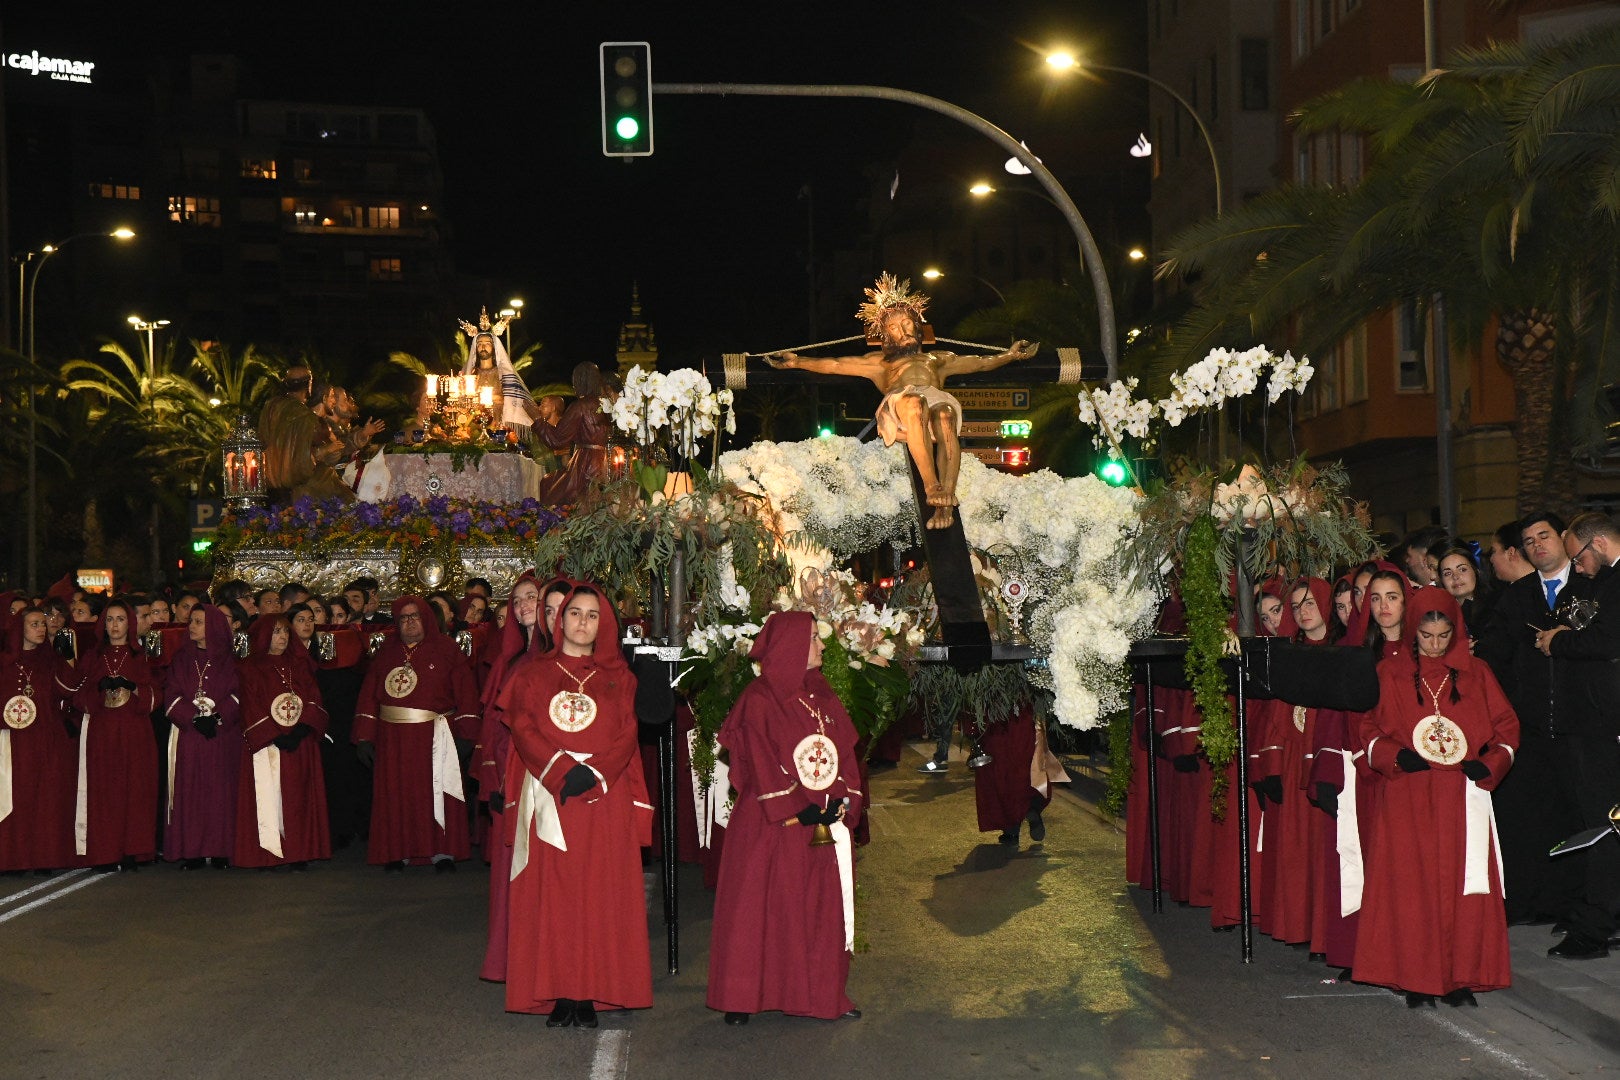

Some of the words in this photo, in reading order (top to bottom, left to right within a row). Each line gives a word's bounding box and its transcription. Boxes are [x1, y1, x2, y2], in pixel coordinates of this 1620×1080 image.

[8, 50, 95, 76] cajamar
[50, 72, 69, 81] CAJA
[1015, 393, 1025, 406] P
[1011, 451, 1020, 462] 2
[196, 503, 214, 524] P
